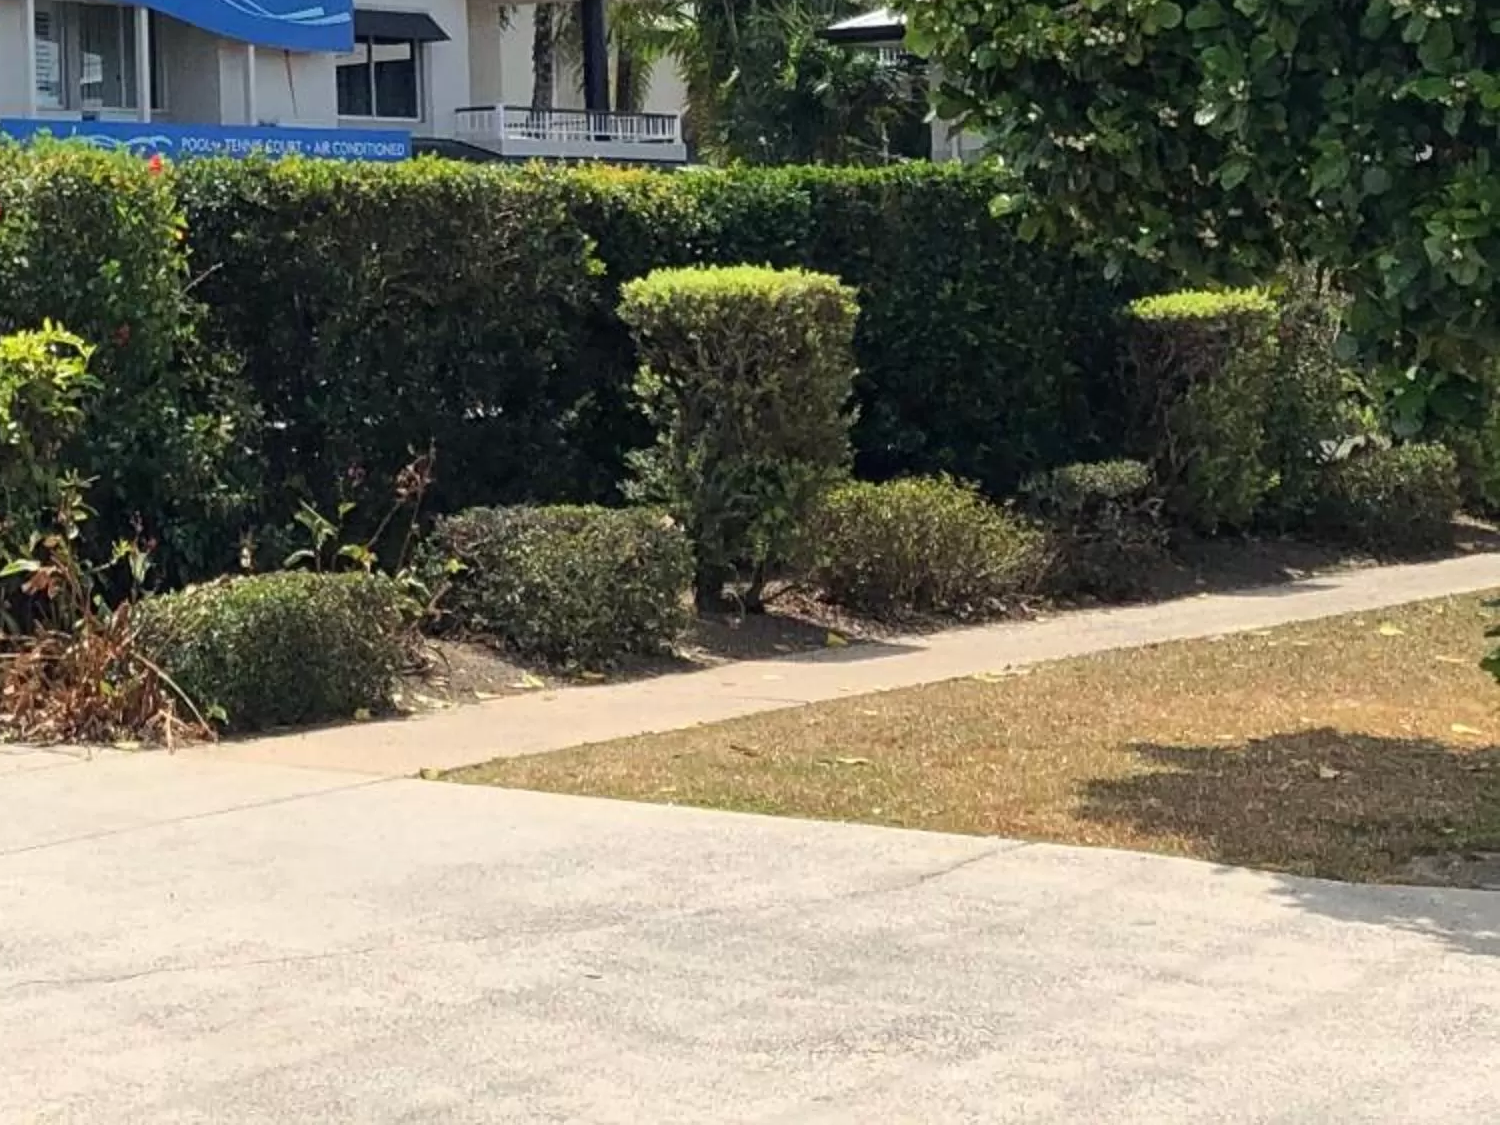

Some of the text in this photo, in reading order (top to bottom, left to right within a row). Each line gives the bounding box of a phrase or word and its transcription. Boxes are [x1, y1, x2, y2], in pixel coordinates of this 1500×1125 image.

[181, 137, 212, 152] POOL
[313, 140, 330, 155] AIR
[331, 141, 405, 156] CONDITIONED
